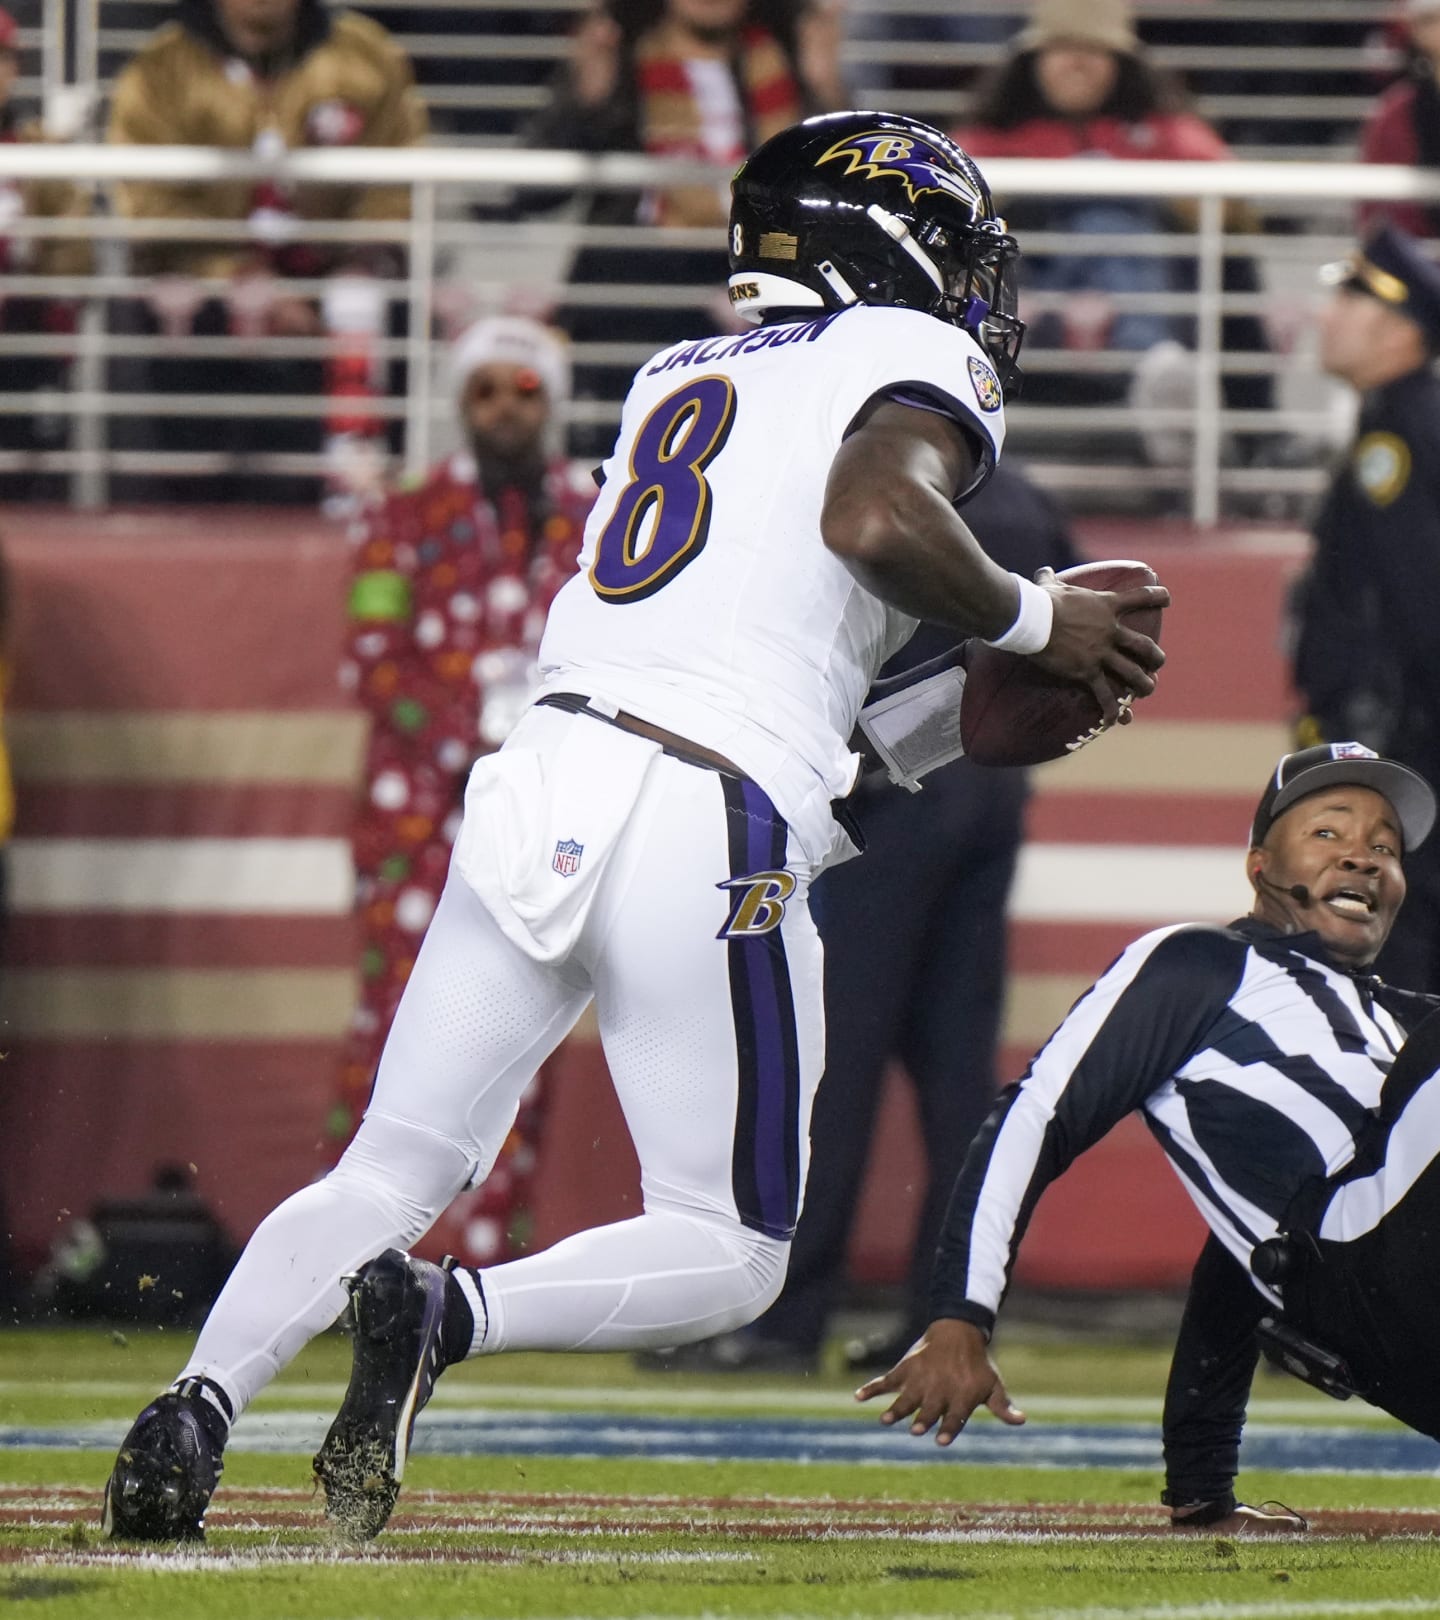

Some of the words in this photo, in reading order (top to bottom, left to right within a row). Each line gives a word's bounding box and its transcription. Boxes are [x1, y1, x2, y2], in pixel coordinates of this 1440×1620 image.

[853, 134, 916, 163] B
[733, 223, 744, 257] 8
[728, 282, 760, 304] ENS
[588, 373, 738, 605] 8
[555, 852, 578, 873] NFL
[715, 868, 797, 939] B
